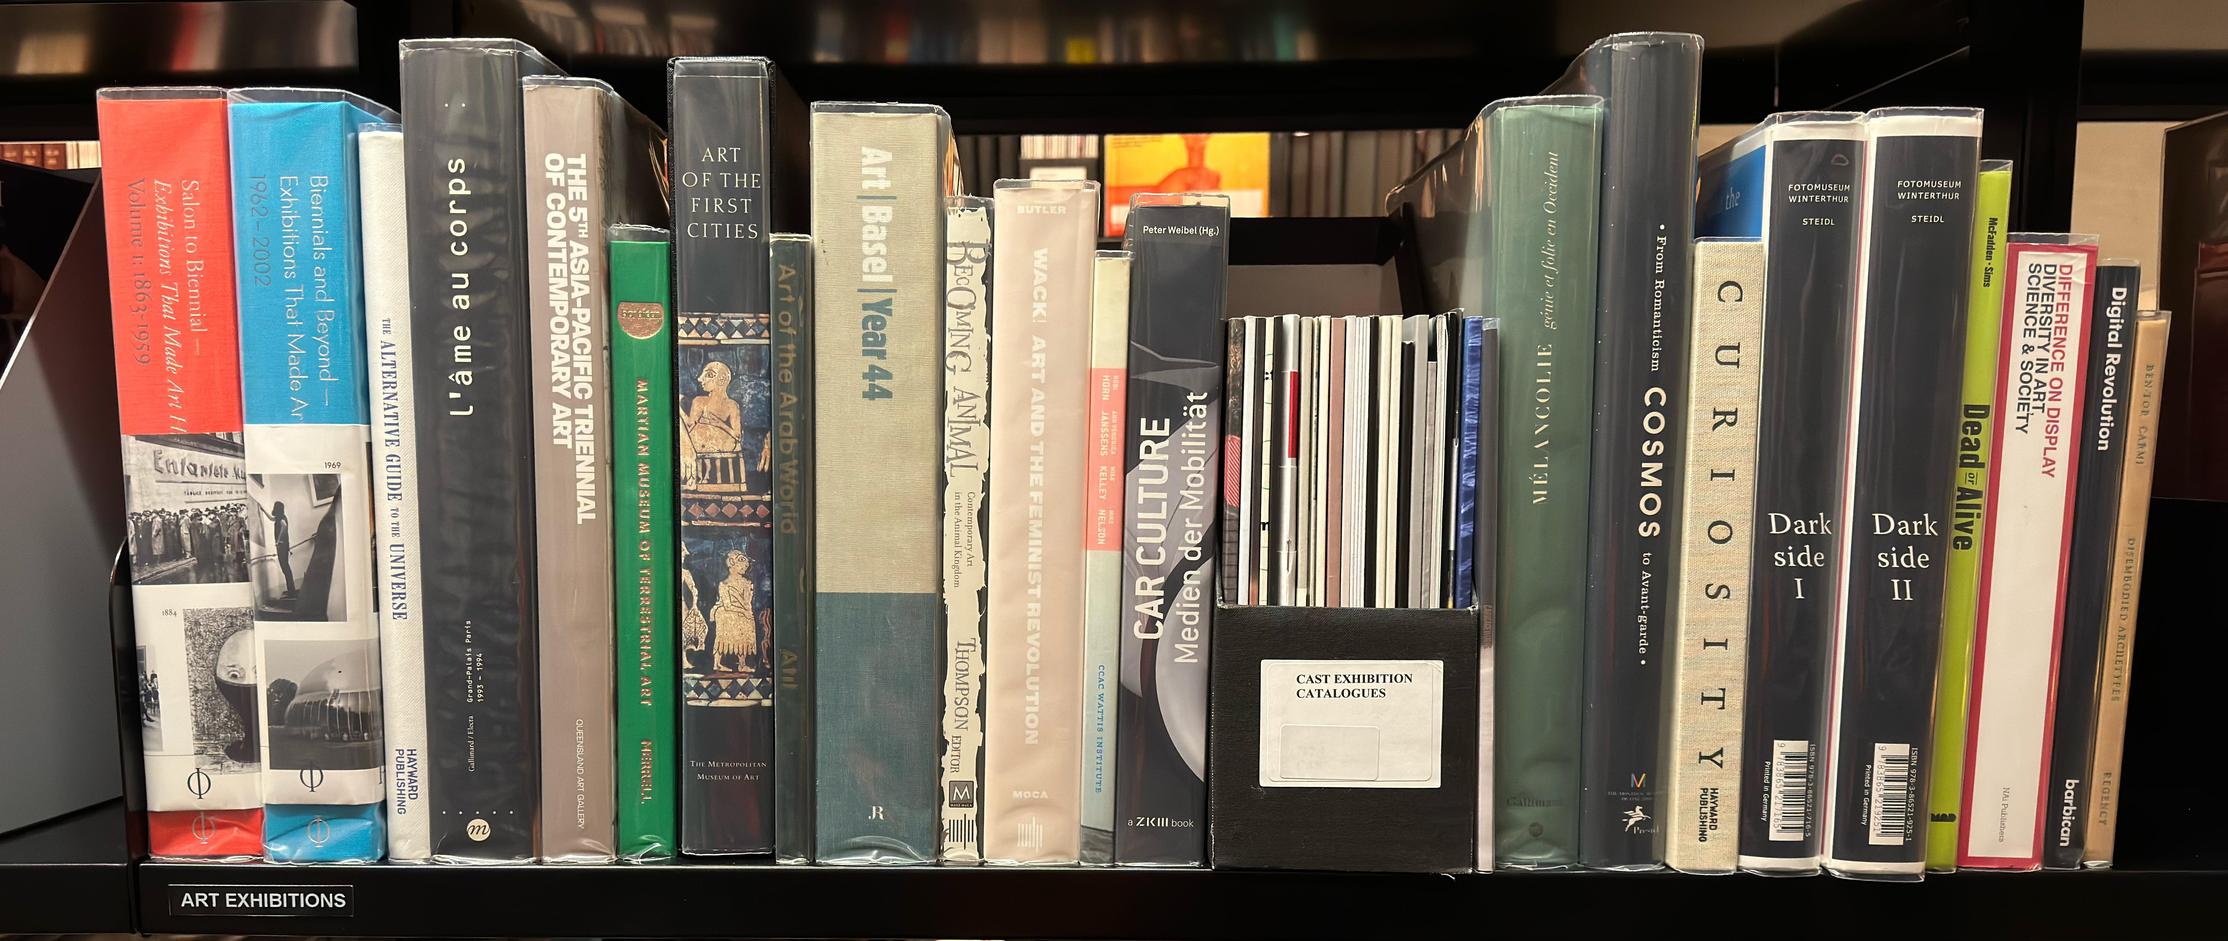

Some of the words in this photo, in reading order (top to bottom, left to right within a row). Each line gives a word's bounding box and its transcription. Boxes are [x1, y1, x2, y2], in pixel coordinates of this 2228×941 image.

[545, 153, 564, 187] OF
[567, 153, 587, 201] THE
[701, 147, 740, 162] ART
[861, 146, 893, 190] Art
[682, 172, 711, 187] OF
[720, 173, 761, 188] THE
[1542, 151, 1559, 215] Occident
[1789, 184, 1850, 192] FOTOMUSEUM
[1789, 195, 1849, 203] WINTERTHUR
[1898, 192, 1960, 200] WINTERTHUR
[127, 178, 146, 249] Volume
[182, 179, 200, 229] Salon
[310, 176, 332, 260] Biennials
[448, 158, 471, 256] corps
[692, 198, 752, 213] FIRST
[1017, 206, 1066, 214] BUTLER
[152, 180, 173, 276] Exhibitions
[184, 233, 198, 254] to
[279, 175, 299, 279] Exhibitions
[687, 223, 758, 239] CITIES
[862, 206, 893, 283] Basel
[1143, 225, 1167, 235] Peter
[1168, 226, 1197, 235] Weibel
[1199, 227, 1219, 236] (Hg.)
[1546, 219, 1556, 236] en
[1985, 218, 1998, 260] McFadden
[1540, 239, 1559, 275] folie
[1655, 236, 1667, 274] From
[1983, 267, 1993, 287] Sims
[160, 281, 179, 320] That
[186, 260, 208, 333] Biennial
[283, 284, 304, 325] That
[314, 266, 335, 302] and
[451, 272, 471, 309] au
[546, 192, 571, 398] CONTEMPORARY
[778, 265, 796, 300] Art
[1032, 248, 1049, 323] WACK!
[2023, 263, 2042, 339] SCIENCE
[132, 272, 152, 366] 1863-1959
[382, 318, 391, 335] THE
[569, 241, 592, 400] ASIA-PACIFIC
[778, 311, 797, 336] of
[862, 297, 893, 360] Year
[1539, 291, 1557, 330] génie
[1651, 279, 1665, 371] Romanticism
[2038, 264, 2057, 353] DIVERSITY
[2050, 264, 2073, 372] DIFFERENCE
[2107, 287, 2128, 348] Digital
[163, 326, 183, 372] Made
[287, 333, 309, 392] Made
[316, 309, 339, 382] Beyond
[779, 343, 796, 384] the
[1031, 335, 1046, 384] ART
[2021, 344, 2034, 354] &
[2035, 358, 2048, 373] IN
[166, 378, 185, 408] Art
[381, 340, 400, 447] ALTERNATIVE
[862, 364, 893, 401] 44
[1102, 375, 1110, 400] HORN
[2016, 360, 2033, 434] SOCIETY
[2049, 377, 2063, 401] ON
[2098, 353, 2121, 450] Revolution
[552, 403, 572, 449] ART
[636, 378, 649, 457] MARTIAN
[779, 393, 798, 452] Arab
[947, 386, 981, 478] ANIMAL
[1030, 387, 1045, 437] AND
[1100, 411, 1109, 456] JANSSENS
[1529, 343, 1552, 504] MÉLANCOLIE
[1180, 392, 1208, 510] Mobilität
[1959, 405, 1990, 468] Dead
[2042, 408, 2061, 478] DISPLAY
[2136, 426, 2147, 465] CARMI
[386, 455, 402, 501] GUIDE
[575, 405, 596, 525] TRIENNIAL
[1029, 440, 1045, 486] THE
[1099, 466, 1108, 500] KELLEY
[1638, 387, 1667, 537] COSMOS
[1967, 473, 1975, 485] or
[391, 508, 399, 519] TO
[637, 463, 651, 534] MUSEUM
[780, 460, 798, 534] World
[955, 492, 962, 500] in
[1136, 418, 1170, 566] CULTURE
[391, 523, 400, 537] THE
[966, 491, 976, 553] Contemporary
[1098, 510, 1106, 544] NELSON
[1178, 518, 1202, 561] der
[1698, 280, 1743, 769] CURIOSITY
[1769, 513, 1832, 536] Dark
[1872, 513, 1938, 536] Dark
[1953, 487, 1983, 550] Alive
[639, 541, 651, 561] OF
[952, 550, 962, 588] Kingdom
[967, 555, 975, 567] Art
[1026, 494, 1043, 599] FEMINIST
[1643, 552, 1652, 563] to
[1774, 545, 1825, 567] side
[1878, 546, 1930, 569] side
[389, 544, 407, 620] UNIVERSE
[1795, 578, 1804, 599] I
[1891, 579, 1913, 600] II
[2120, 538, 2135, 620] DISEMBODIED
[162, 609, 177, 617] 1884
[639, 568, 652, 670] TERRESTRIAL
[1134, 575, 1164, 640] CAR
[1174, 572, 1200, 663] Medien
[1637, 570, 1652, 654] Avant-garde
[640, 676, 652, 706] ART
[954, 637, 976, 731] THOMPSON
[1024, 603, 1042, 746] REVOLUTION
[1296, 674, 1330, 684] CAST
[1334, 674, 1413, 683] EXHIBITION
[1296, 688, 1386, 698] CATALOGUES
[576, 719, 584, 774] QUEENSLAND
[950, 735, 962, 773] EDITOR
[1095, 736, 1103, 793] INSTITUTE
[396, 749, 407, 815] PUBLISHING
[406, 749, 418, 800] HAYWARD
[576, 776, 584, 791] ART
[577, 793, 585, 828] GALLERY
[1699, 788, 1708, 842] PUBLISHING
[1709, 788, 1718, 830] HAYWARD
[1761, 794, 1769, 821] Germany
[1861, 798, 1869, 825] Germany
[1906, 769, 1916, 841] 978-3-86521-925-1
[2060, 780, 2079, 846] barbican
[2099, 772, 2111, 825] REGENCY
[1172, 819, 1194, 827] book
[181, 893, 219, 908] ART
[225, 893, 346, 908] EXHIBITIONS
